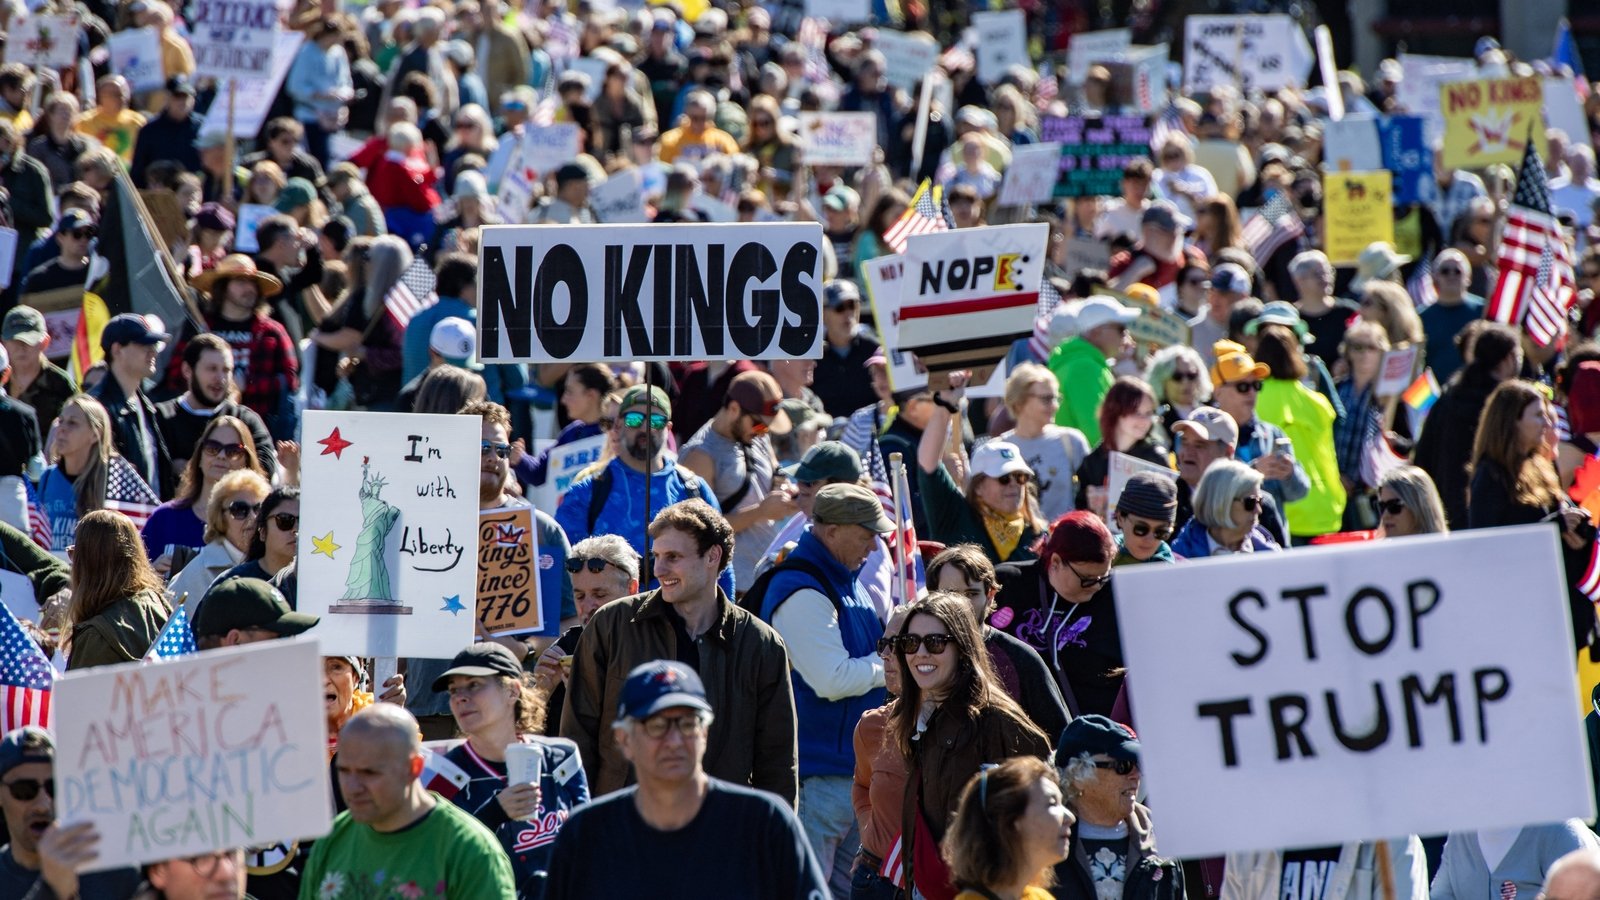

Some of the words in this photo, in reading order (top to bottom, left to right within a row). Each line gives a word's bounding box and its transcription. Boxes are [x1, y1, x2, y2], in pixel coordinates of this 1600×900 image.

[1448, 82, 1480, 113] NO
[481, 243, 588, 359] NO
[603, 241, 820, 357] KINGS
[919, 253, 1024, 295] NOPE
[404, 434, 442, 463] I'm
[416, 475, 457, 499] with
[400, 526, 464, 572] Liberty
[478, 541, 531, 570] ings
[479, 565, 531, 593] ince
[1226, 579, 1443, 668] STOP
[111, 656, 248, 715] MAKE
[78, 703, 288, 769] AMERICA
[1196, 666, 1513, 768] TRUMP
[63, 743, 315, 817] DEMOCRATIC
[126, 790, 255, 852] AGAIN
